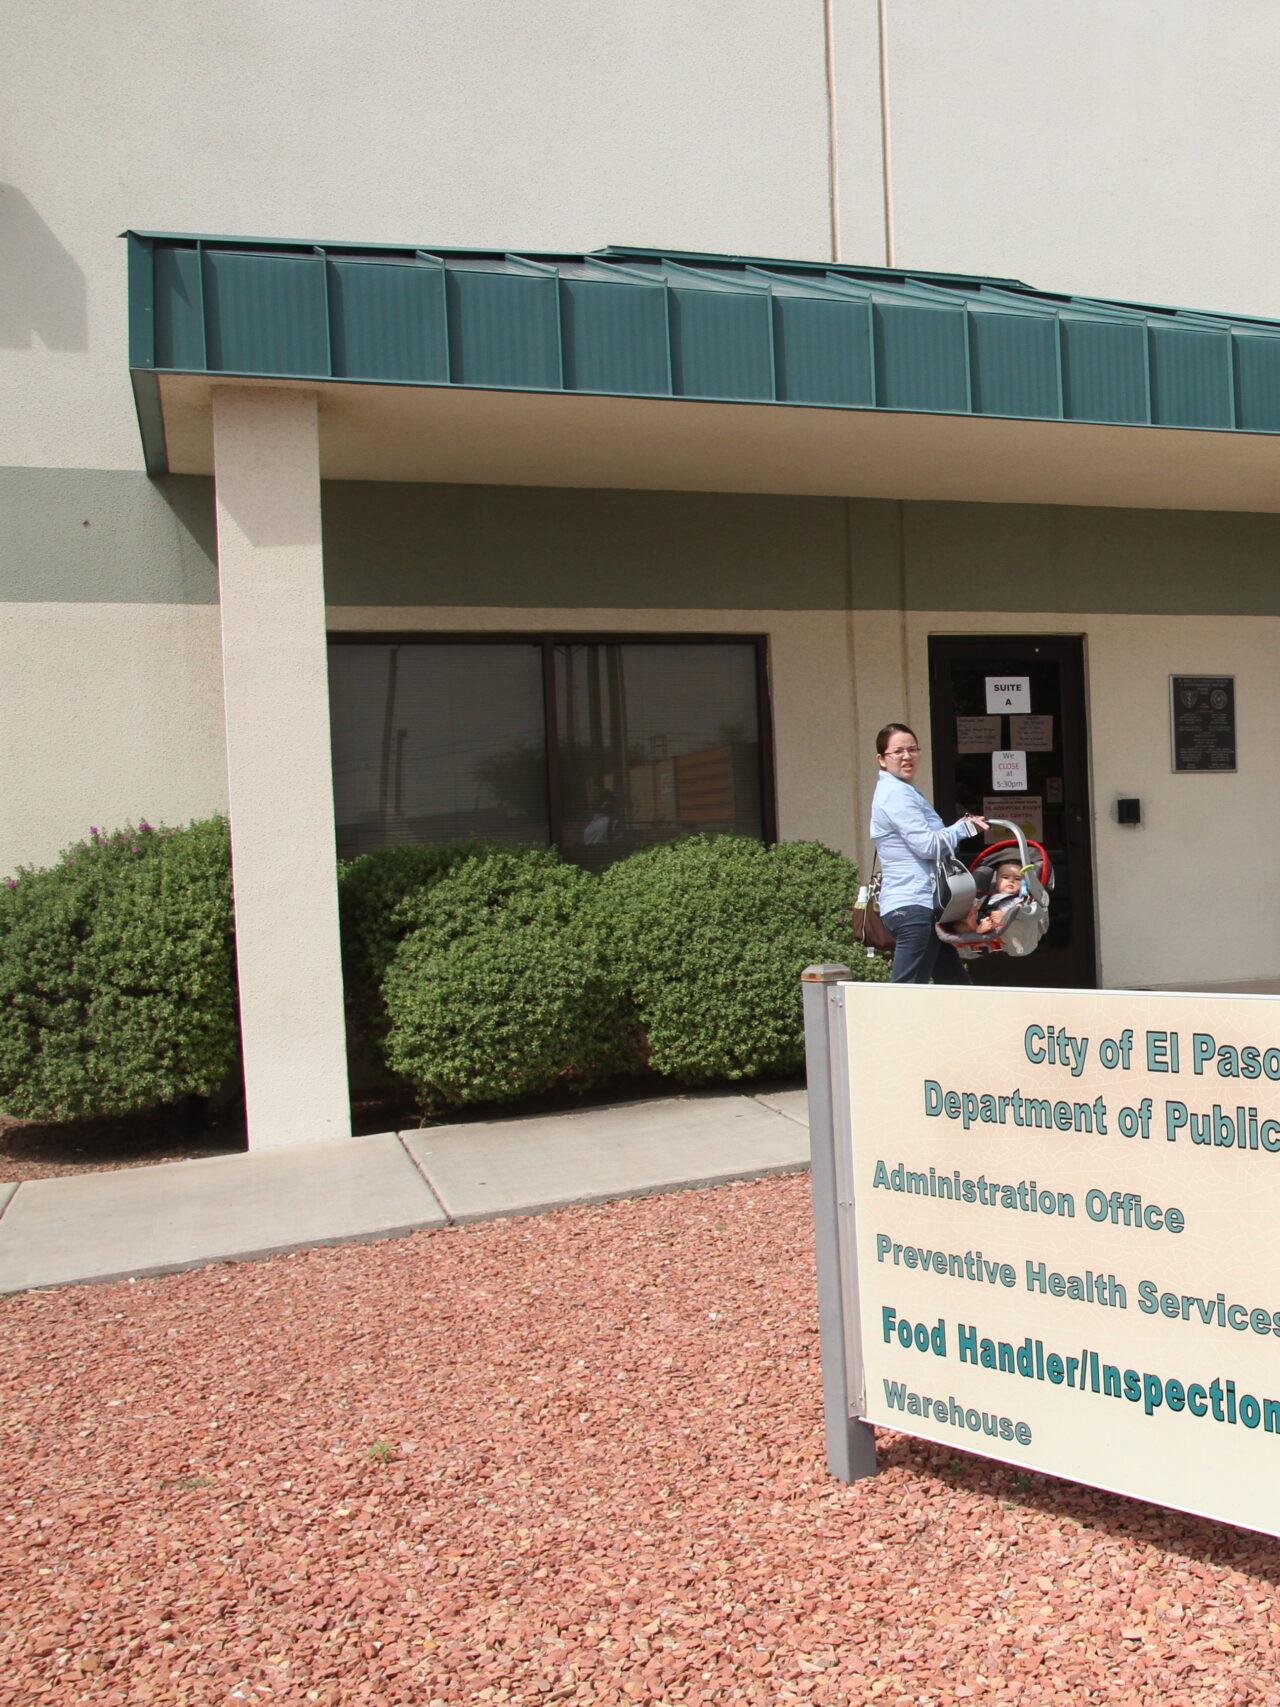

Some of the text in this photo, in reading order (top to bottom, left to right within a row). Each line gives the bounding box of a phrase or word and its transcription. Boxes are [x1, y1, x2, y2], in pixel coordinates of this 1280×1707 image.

[1005, 698, 1012, 706] A
[996, 780, 1023, 789] 5:30pm
[998, 762, 1020, 770] CLOSE
[1024, 1023, 1090, 1078] City
[1098, 1028, 1134, 1071] of
[1145, 1030, 1180, 1074] El
[923, 1079, 1108, 1136] Department
[1117, 1098, 1153, 1140] of
[872, 1159, 1185, 1233] Administration Office
[876, 1233, 1017, 1288] Preventive
[1025, 1259, 1128, 1310] Health
[881, 1305, 947, 1358] Food
[882, 1378, 1033, 1446] Warehouse
